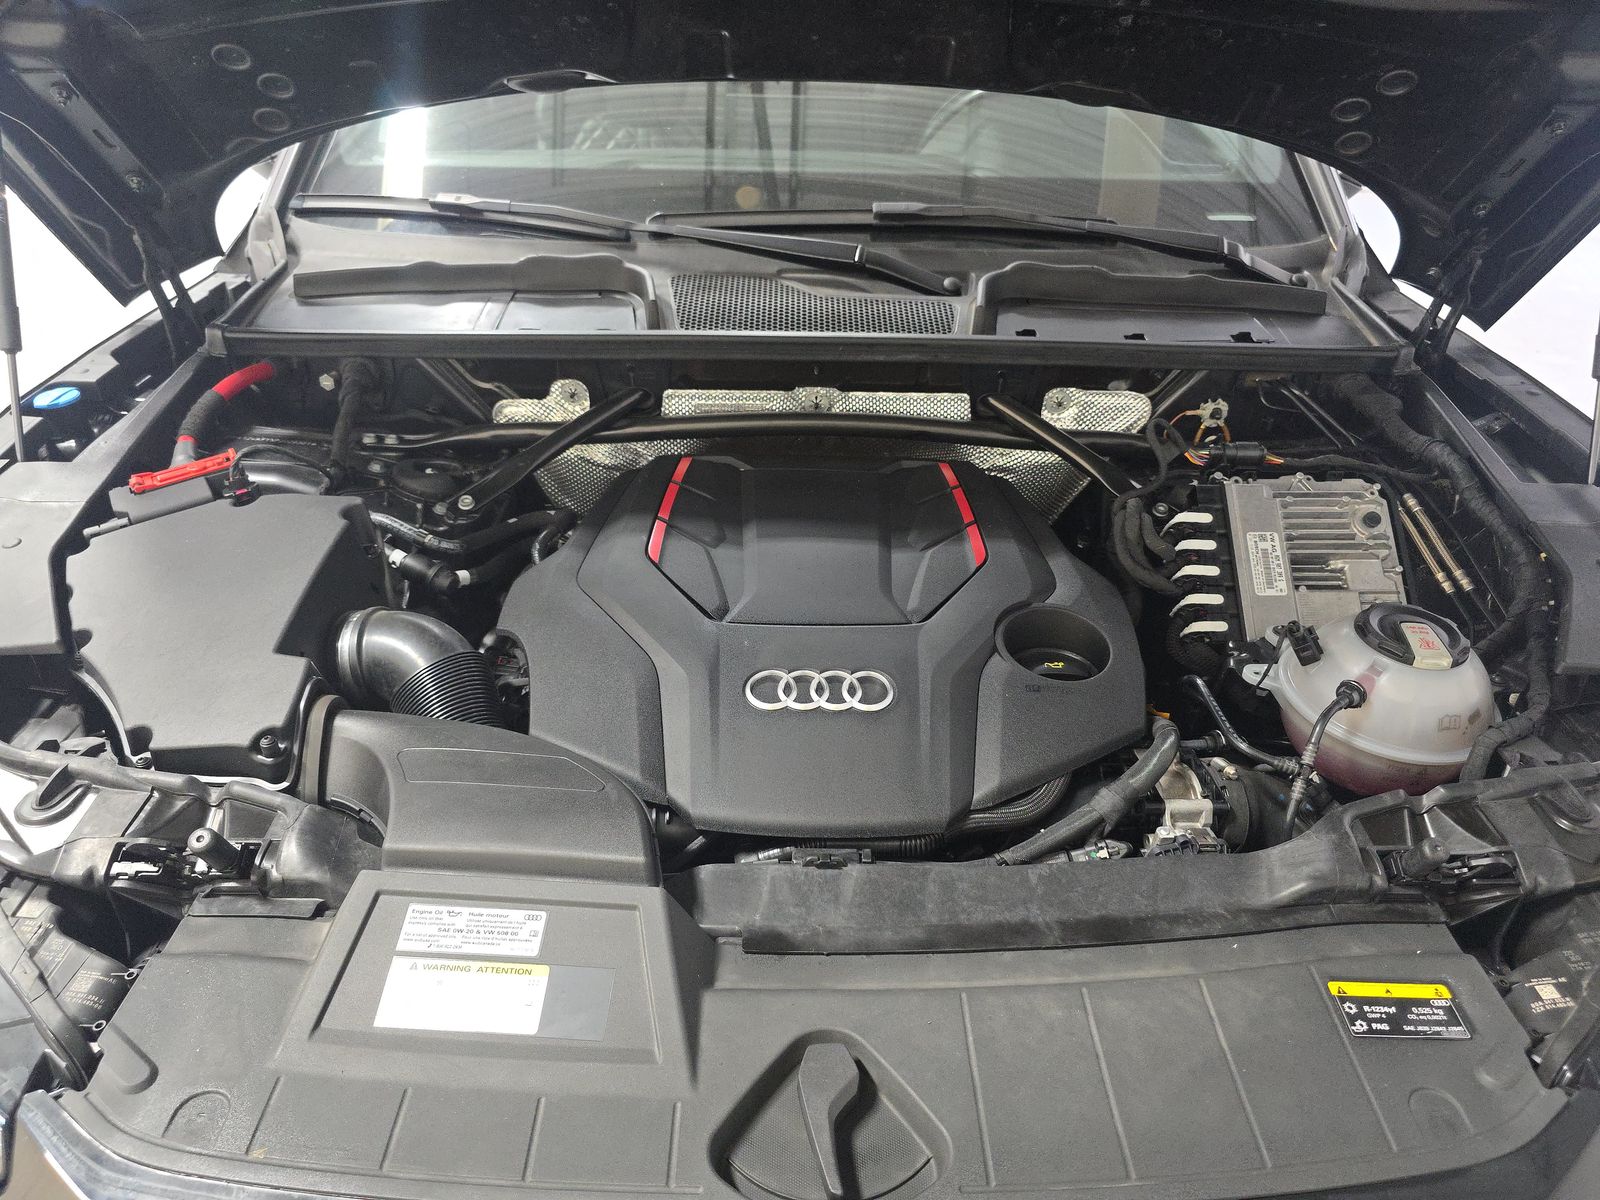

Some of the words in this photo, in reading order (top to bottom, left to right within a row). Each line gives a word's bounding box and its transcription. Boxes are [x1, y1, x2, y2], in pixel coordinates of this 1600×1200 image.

[422, 963, 472, 972] WARNING
[476, 966, 532, 975] ATTENTION
[1363, 1005, 1396, 1014] R-1234yf
